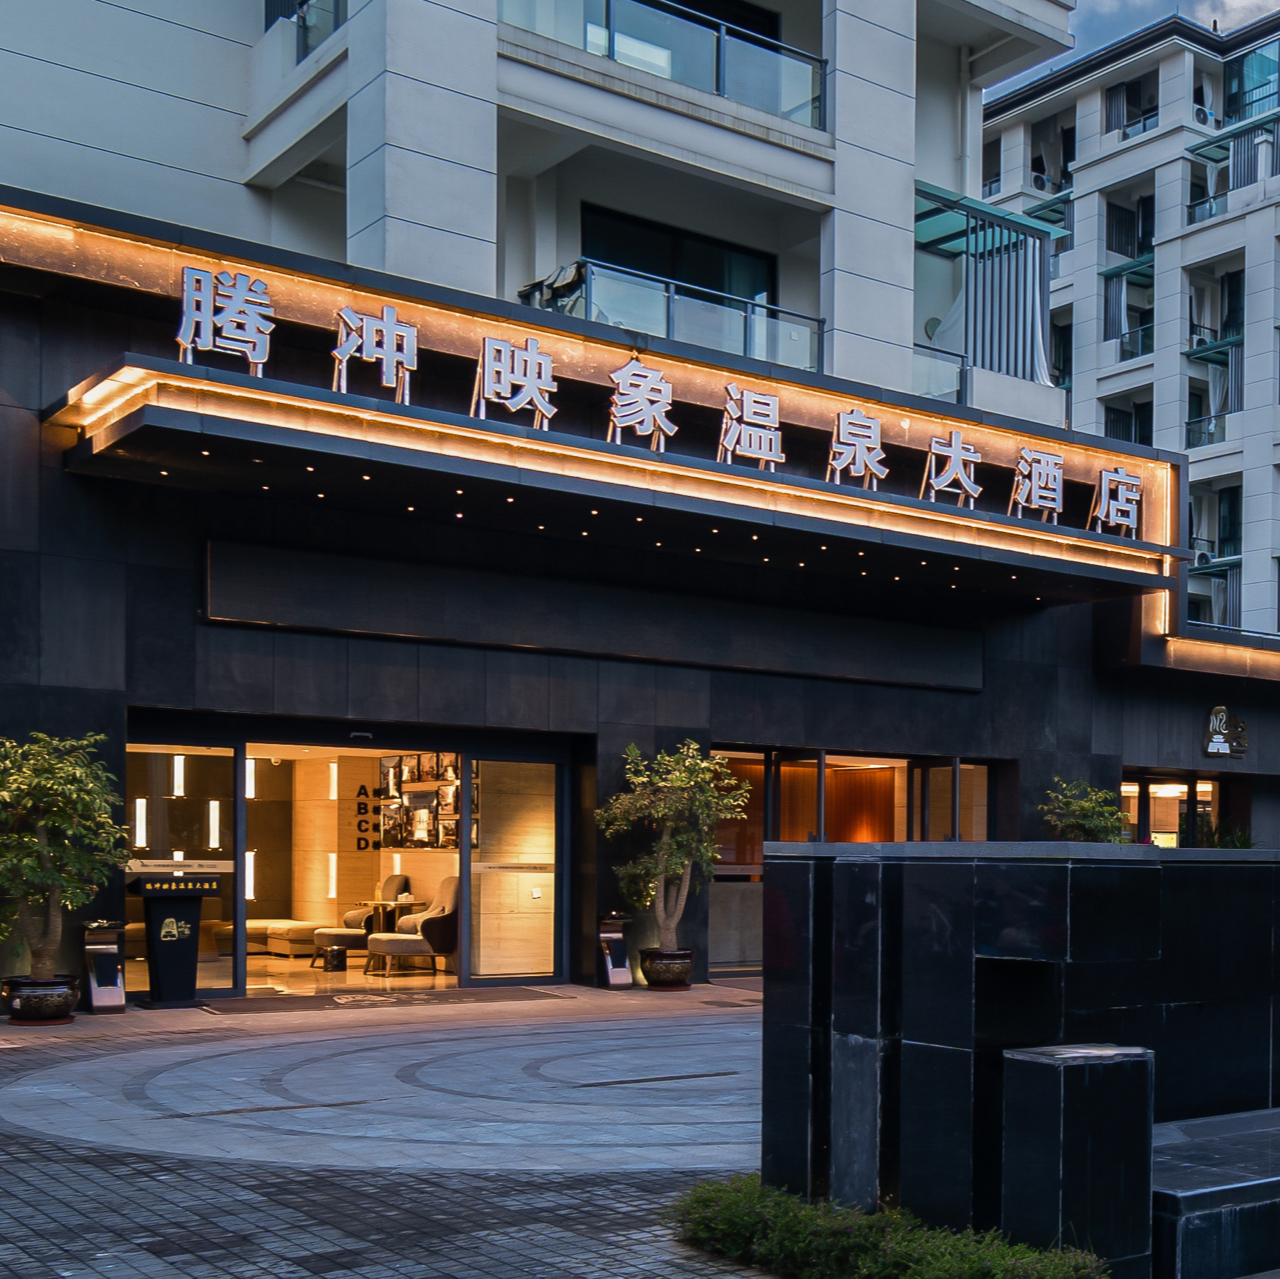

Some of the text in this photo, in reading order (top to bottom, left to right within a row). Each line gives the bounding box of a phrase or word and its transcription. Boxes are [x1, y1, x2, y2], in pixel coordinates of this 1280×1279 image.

[176, 265, 1142, 528] 腾冲映象温泉大酒店
